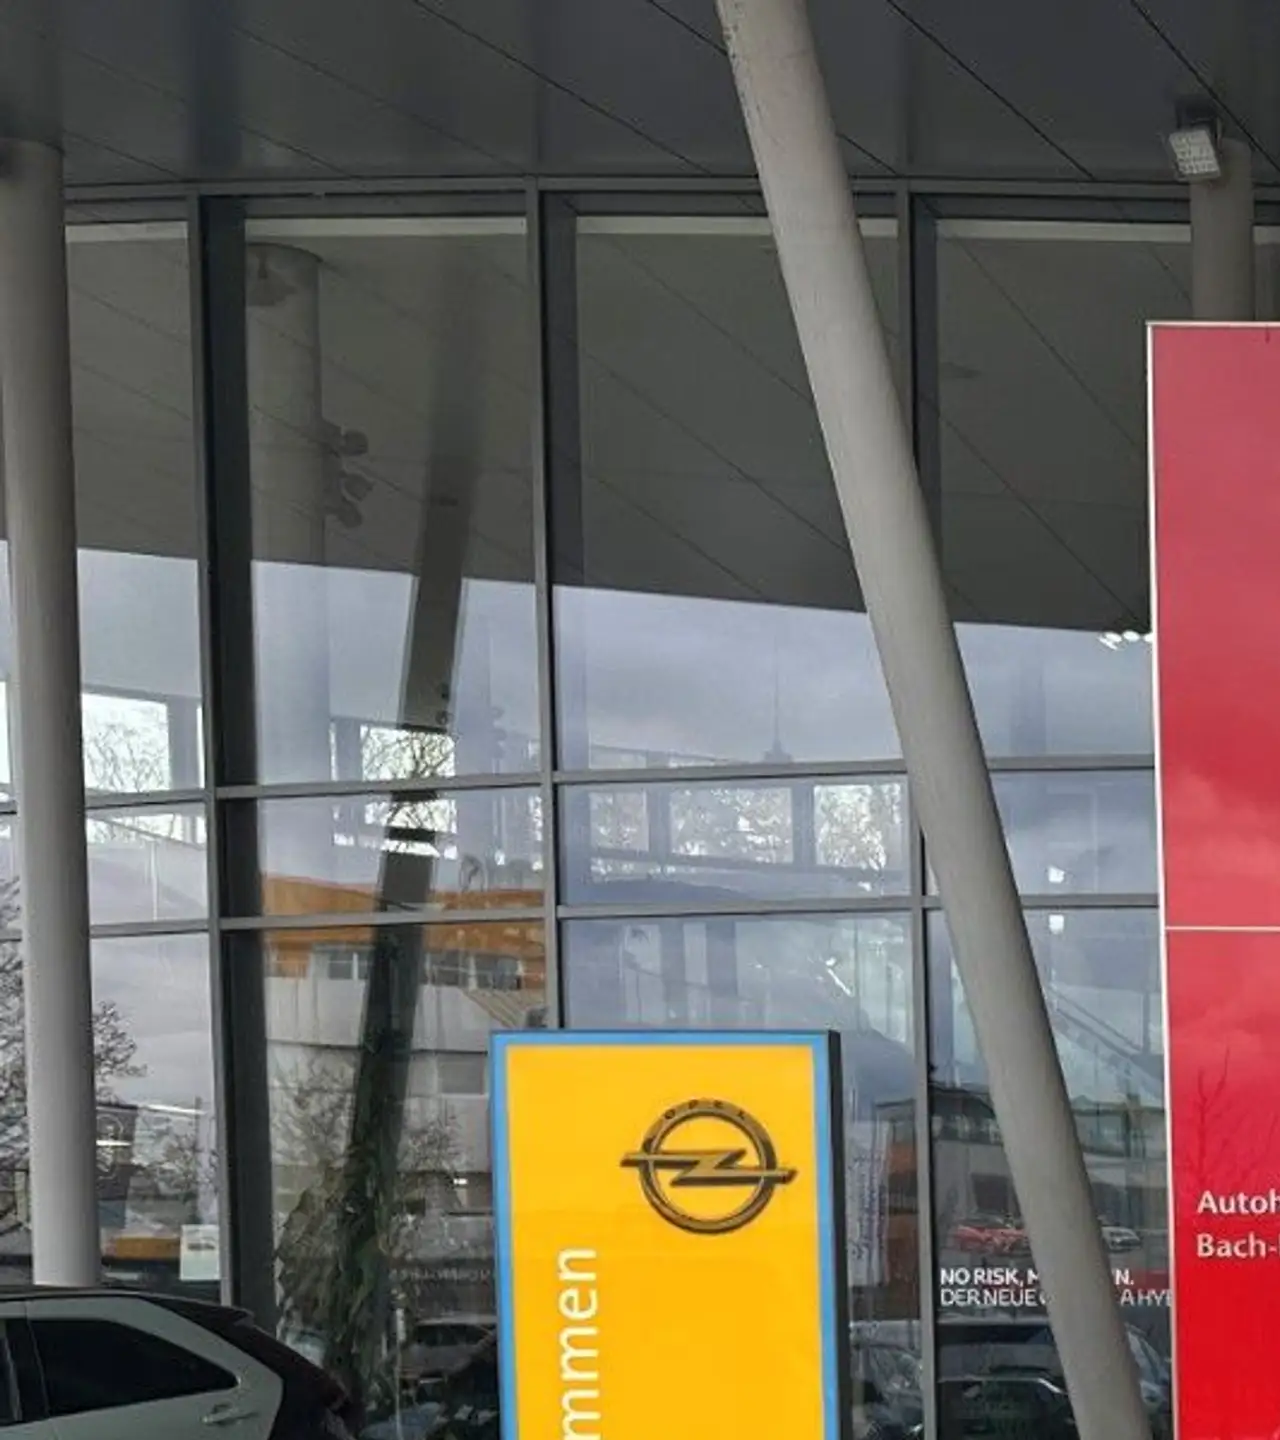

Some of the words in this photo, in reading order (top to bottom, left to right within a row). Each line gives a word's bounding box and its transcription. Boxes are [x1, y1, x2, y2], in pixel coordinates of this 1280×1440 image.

[664, 1099, 748, 1121] OPEL
[939, 1267, 971, 1286] NO
[974, 1267, 1025, 1288] RISK,
[940, 1288, 980, 1307] DER
[983, 1288, 1040, 1308] NEUE
